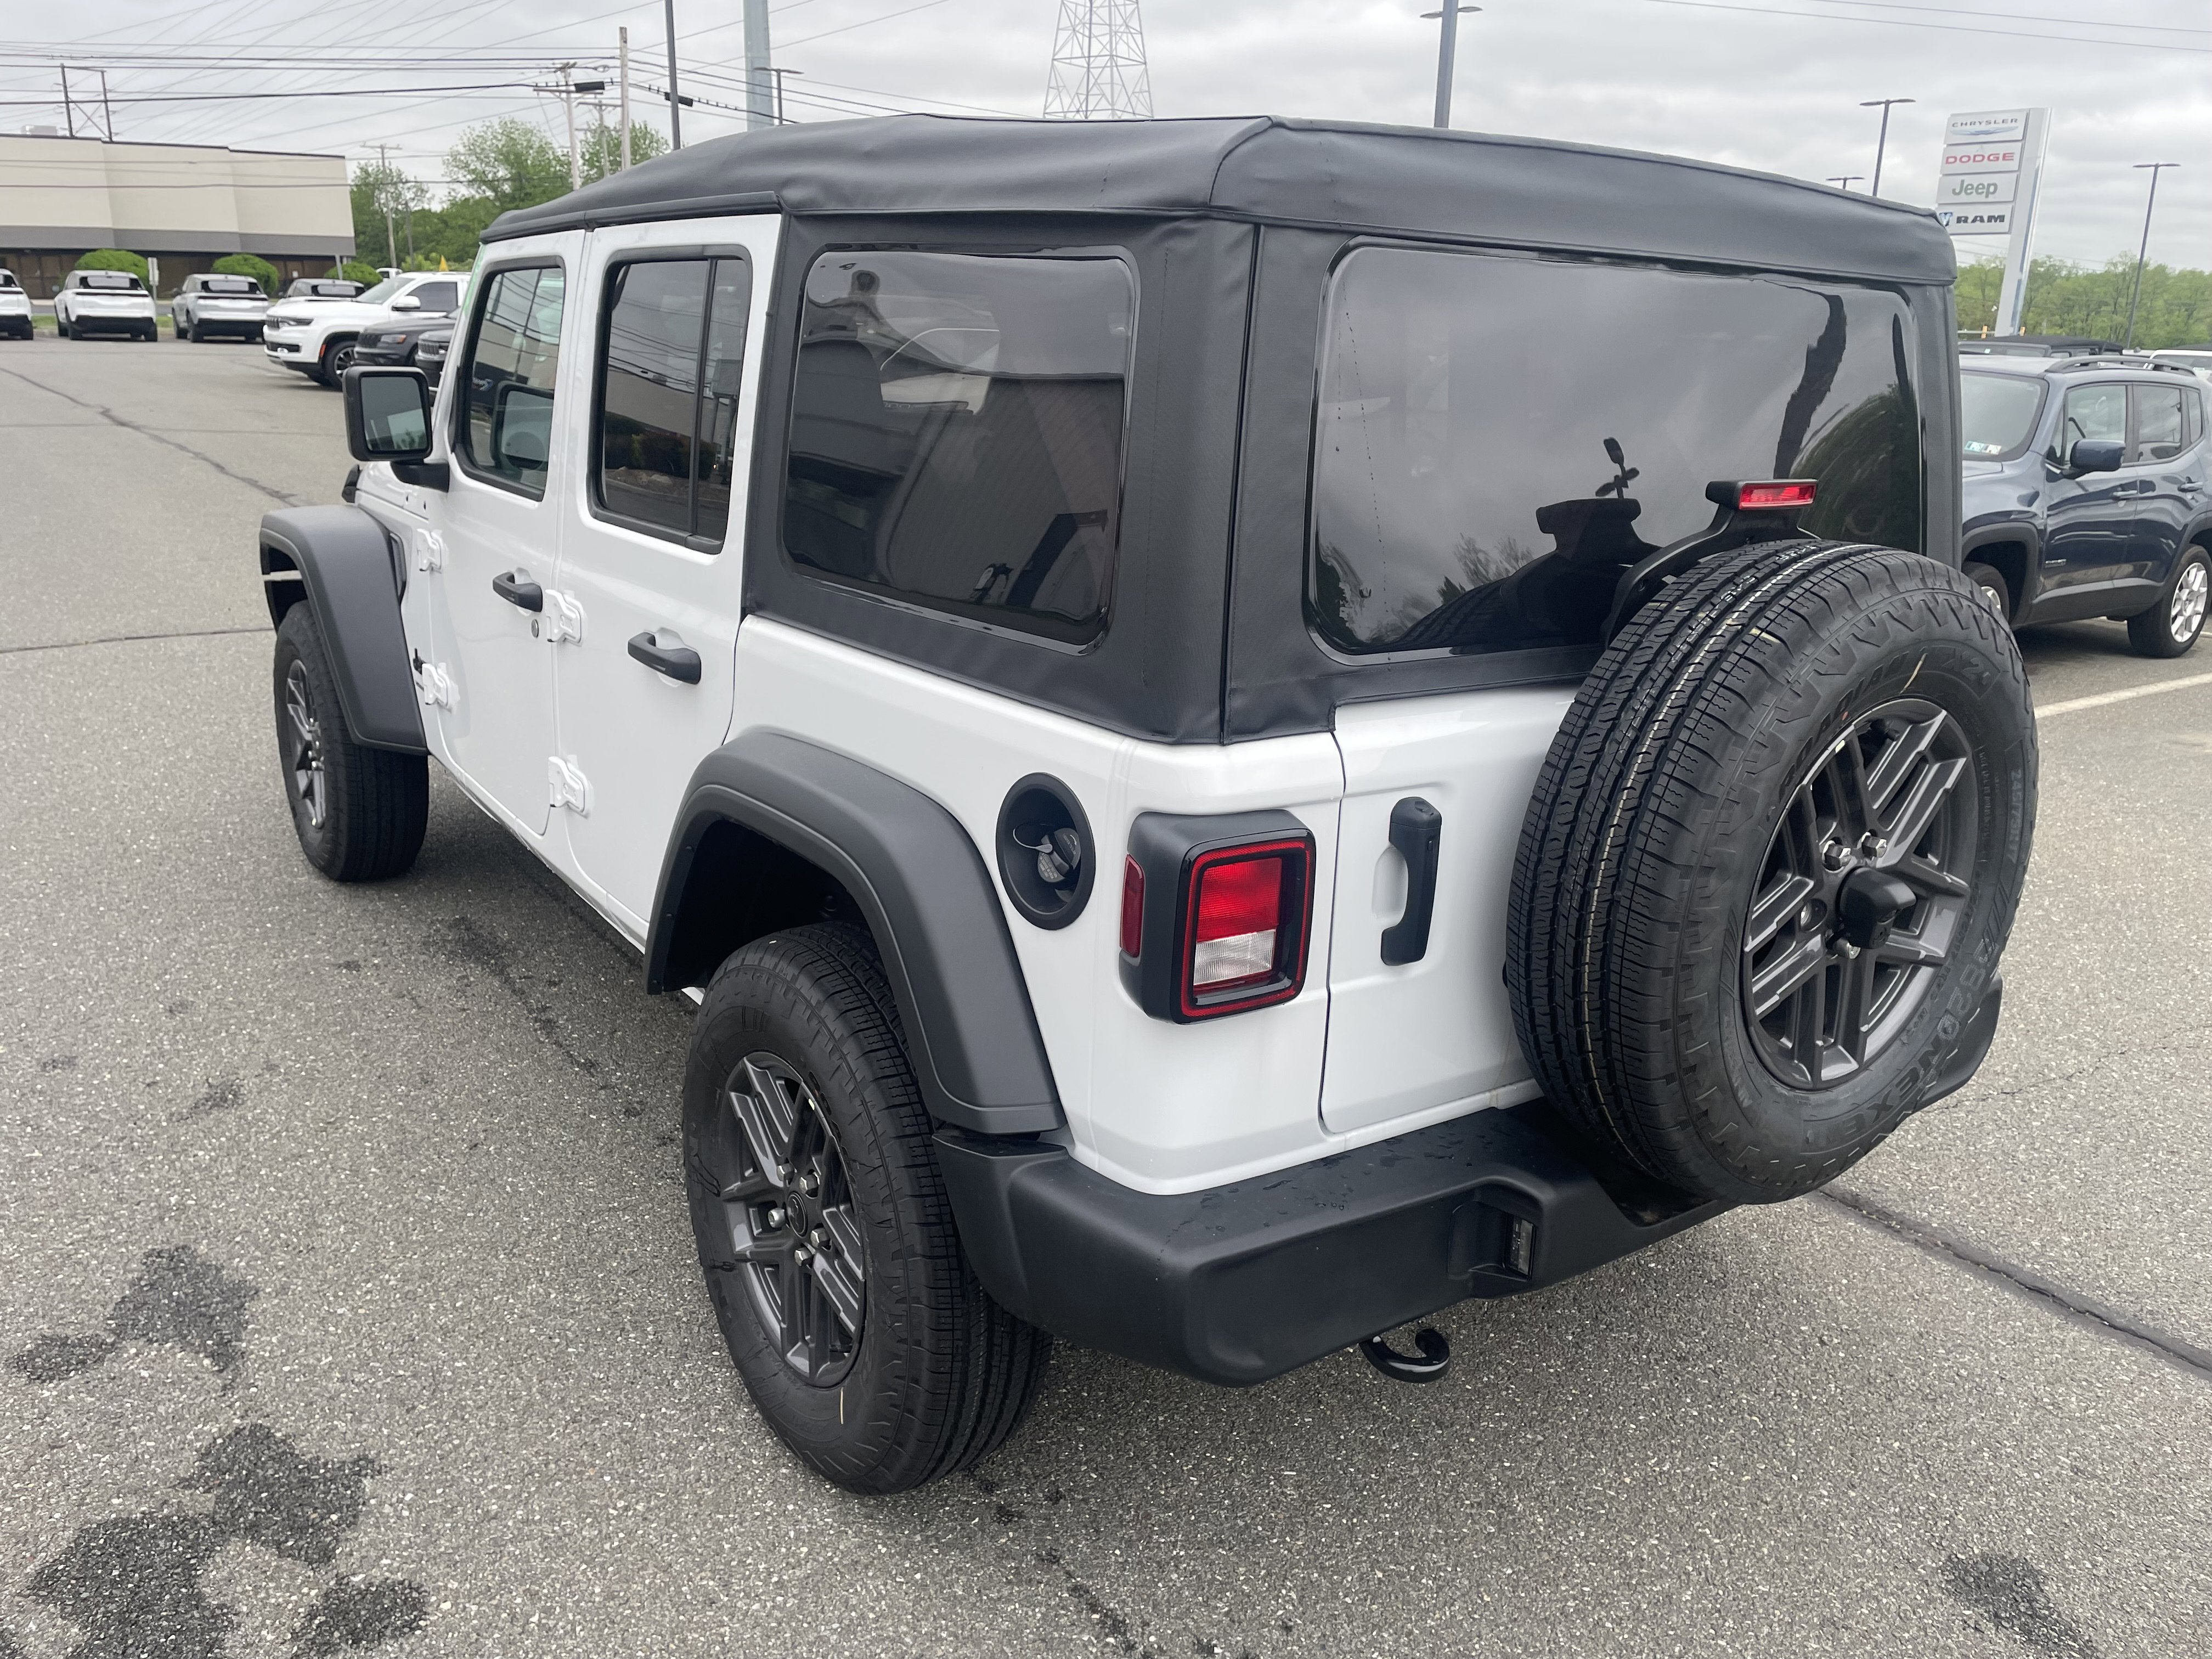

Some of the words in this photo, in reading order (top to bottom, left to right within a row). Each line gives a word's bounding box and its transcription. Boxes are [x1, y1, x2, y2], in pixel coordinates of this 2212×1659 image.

[1952, 118, 2019, 127] CHRYSLER
[1945, 153, 2015, 164] DODGE
[1952, 179, 1998, 198] Jeep
[1956, 215, 2006, 224] RAM
[1822, 1031, 1945, 1143] NEXE
